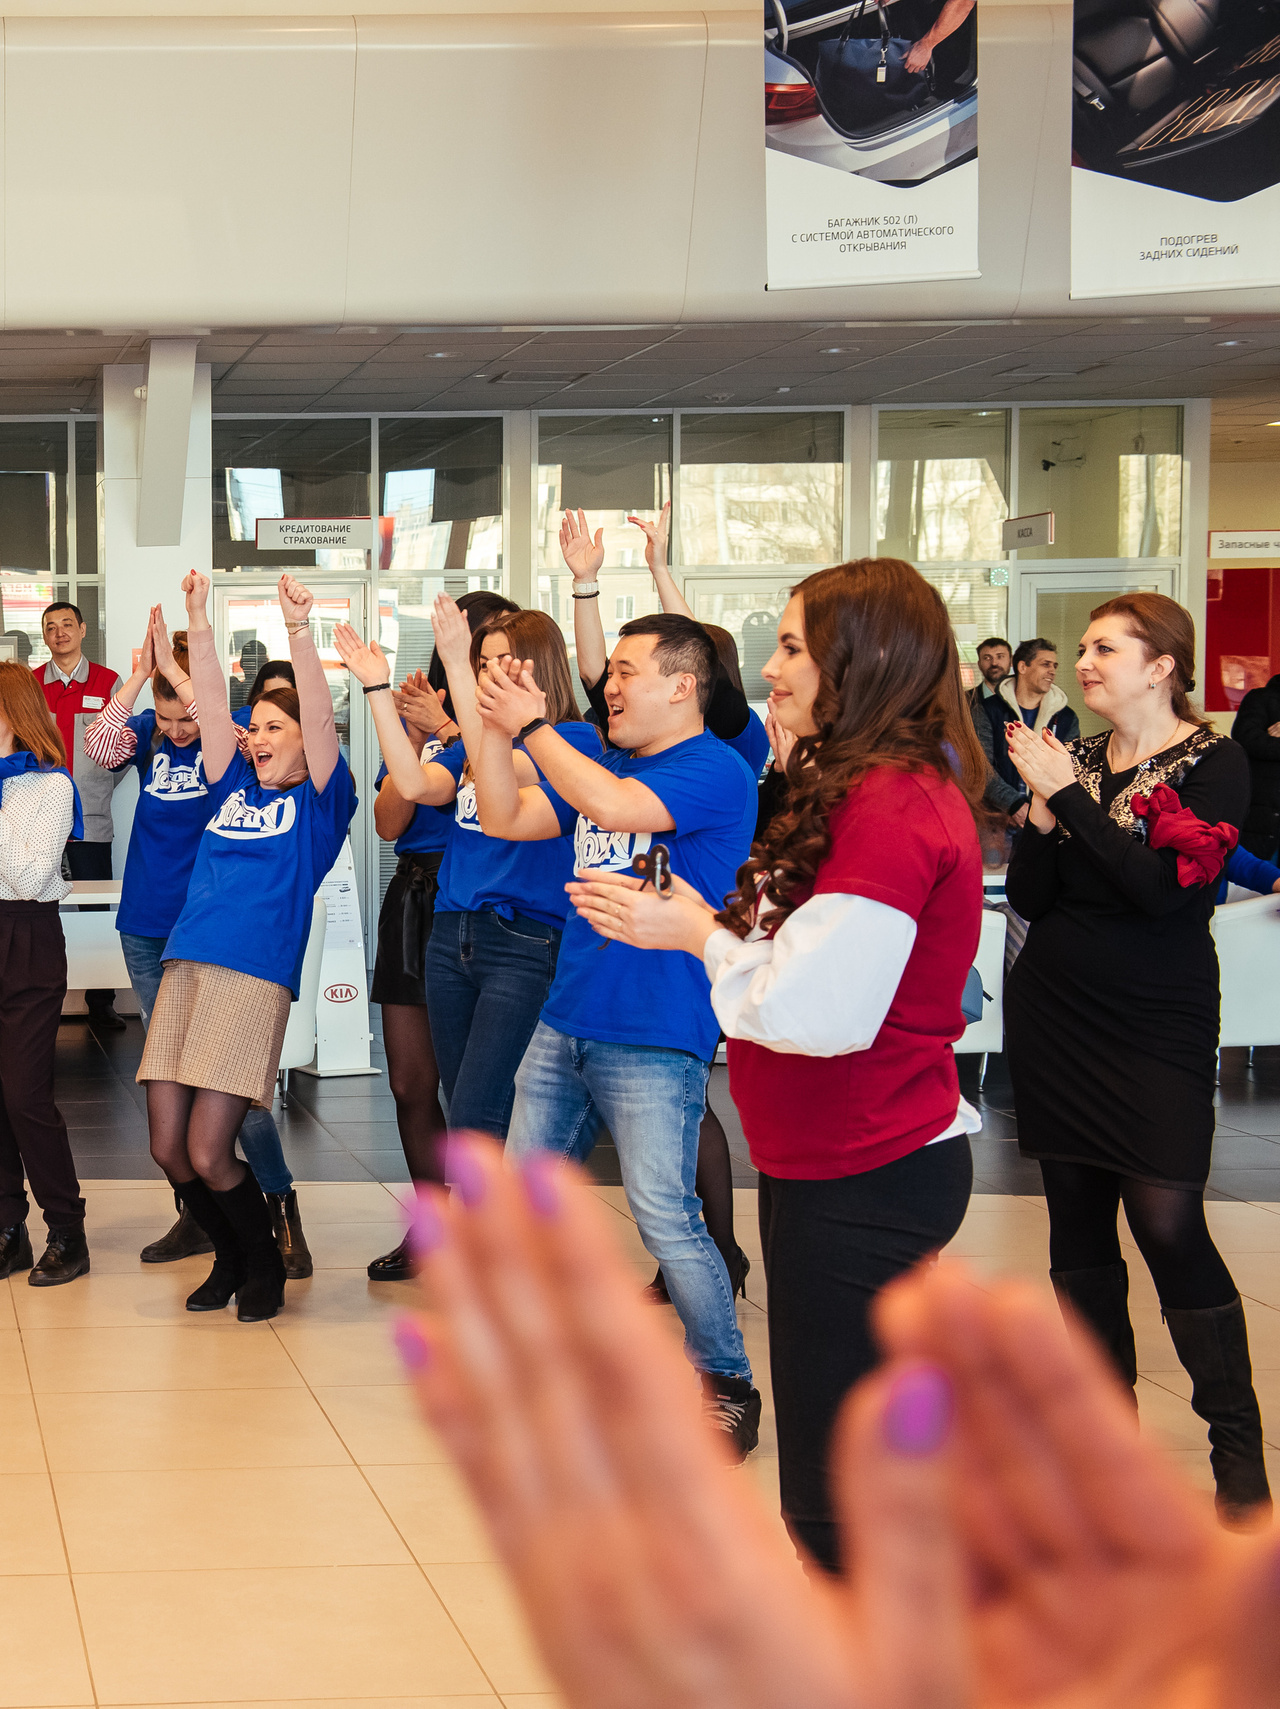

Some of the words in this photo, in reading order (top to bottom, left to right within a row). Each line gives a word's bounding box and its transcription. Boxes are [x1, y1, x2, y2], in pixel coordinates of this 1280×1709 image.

[827, 216, 881, 228] БАГАЖНИК
[883, 215, 901, 226] 502
[903, 214, 918, 225] (Л)
[791, 233, 797, 243] С
[799, 229, 854, 243] СИСТЕМОЙ
[856, 225, 954, 240] АВТОМАТИЧЕСКОГО
[1160, 234, 1218, 247] ПОДОГРЕВ
[839, 241, 907, 253] ОТКРЫВАНИЯ
[1139, 249, 1183, 261] ЗАДНИХ
[1186, 244, 1239, 258] СИДЕНИЙ
[279, 524, 351, 534] КРЕДИТОВАНИЕ
[283, 536, 347, 545] СТРАХОВАНИЕ
[1218, 539, 1270, 549] Запасные
[330, 987, 353, 999] KIA
